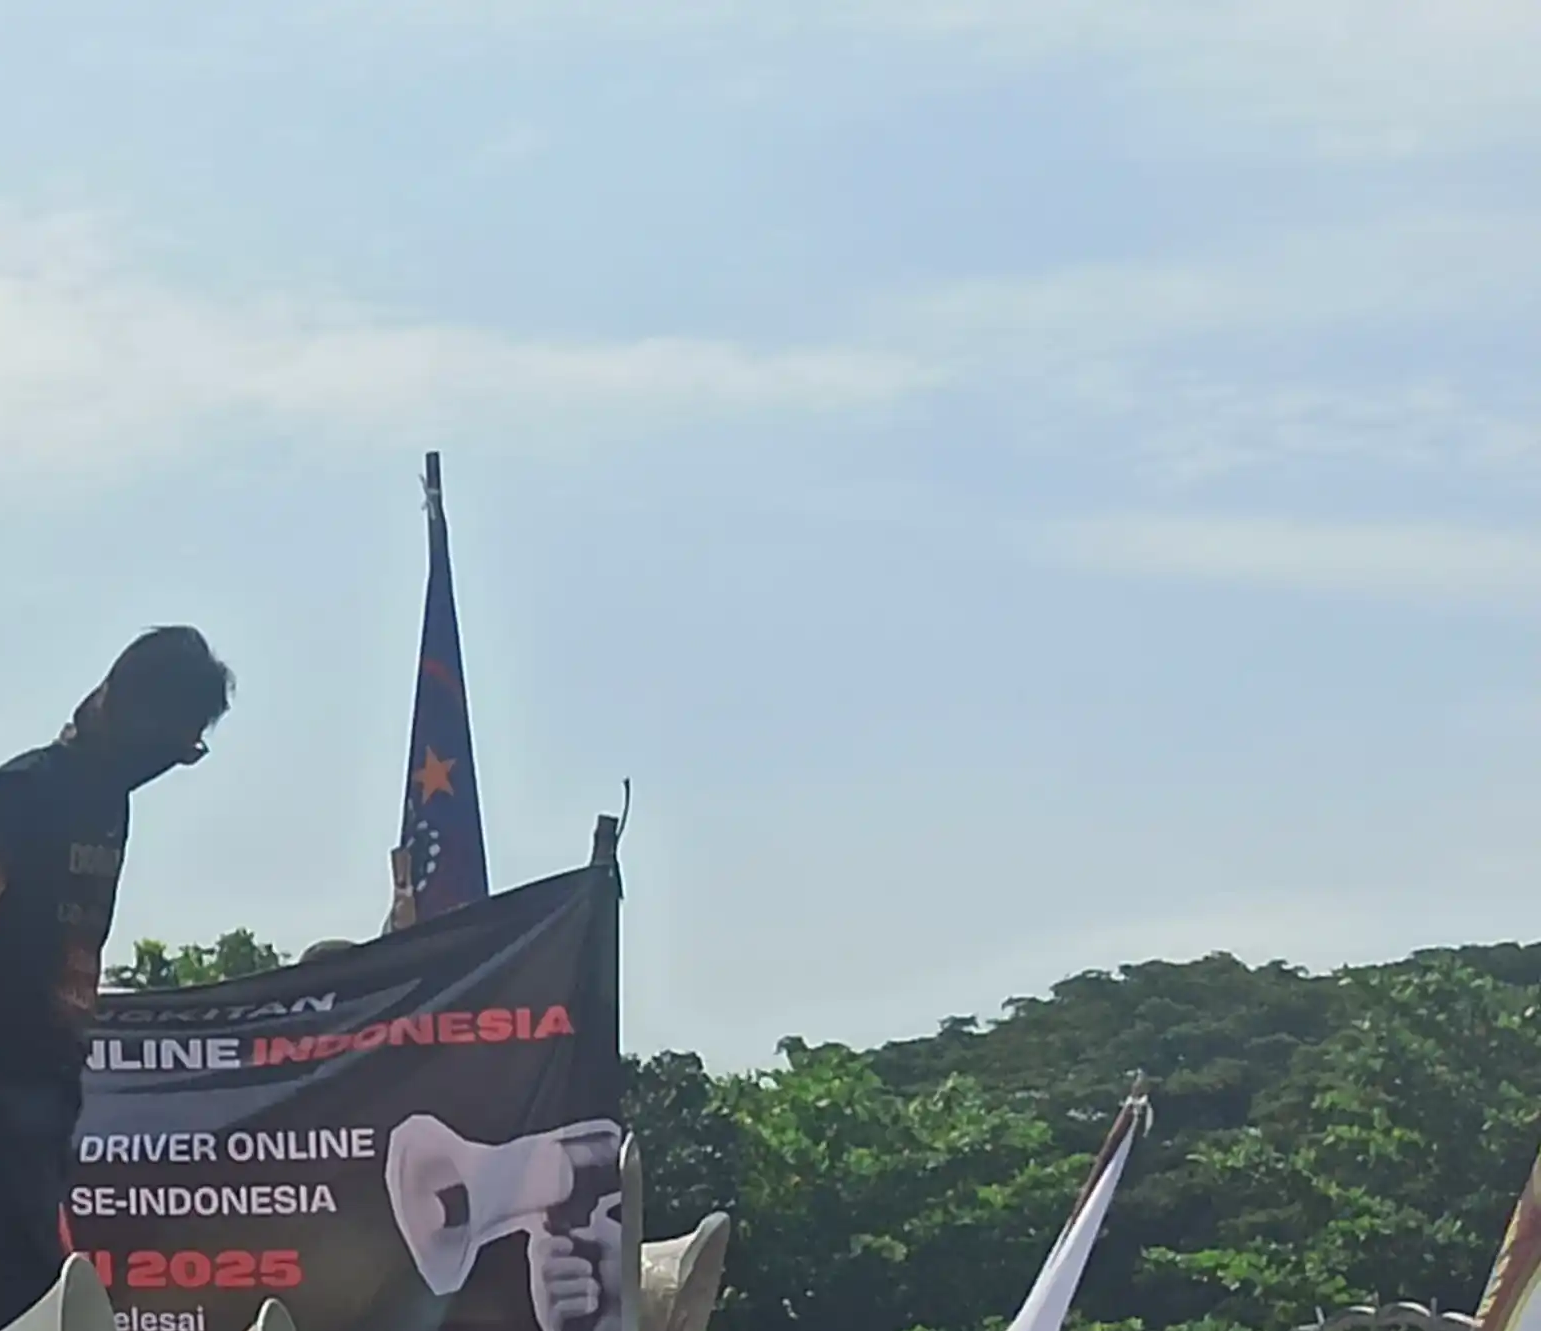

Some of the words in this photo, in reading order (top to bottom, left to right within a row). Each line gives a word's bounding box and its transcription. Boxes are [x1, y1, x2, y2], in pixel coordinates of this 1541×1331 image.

[252, 1005, 575, 1067] INDONESIA
[79, 1131, 217, 1164] DRIVER
[227, 1127, 376, 1162] ONLINE
[70, 1184, 337, 1217] SE-INDONESIA
[126, 1249, 303, 1288] 2025
